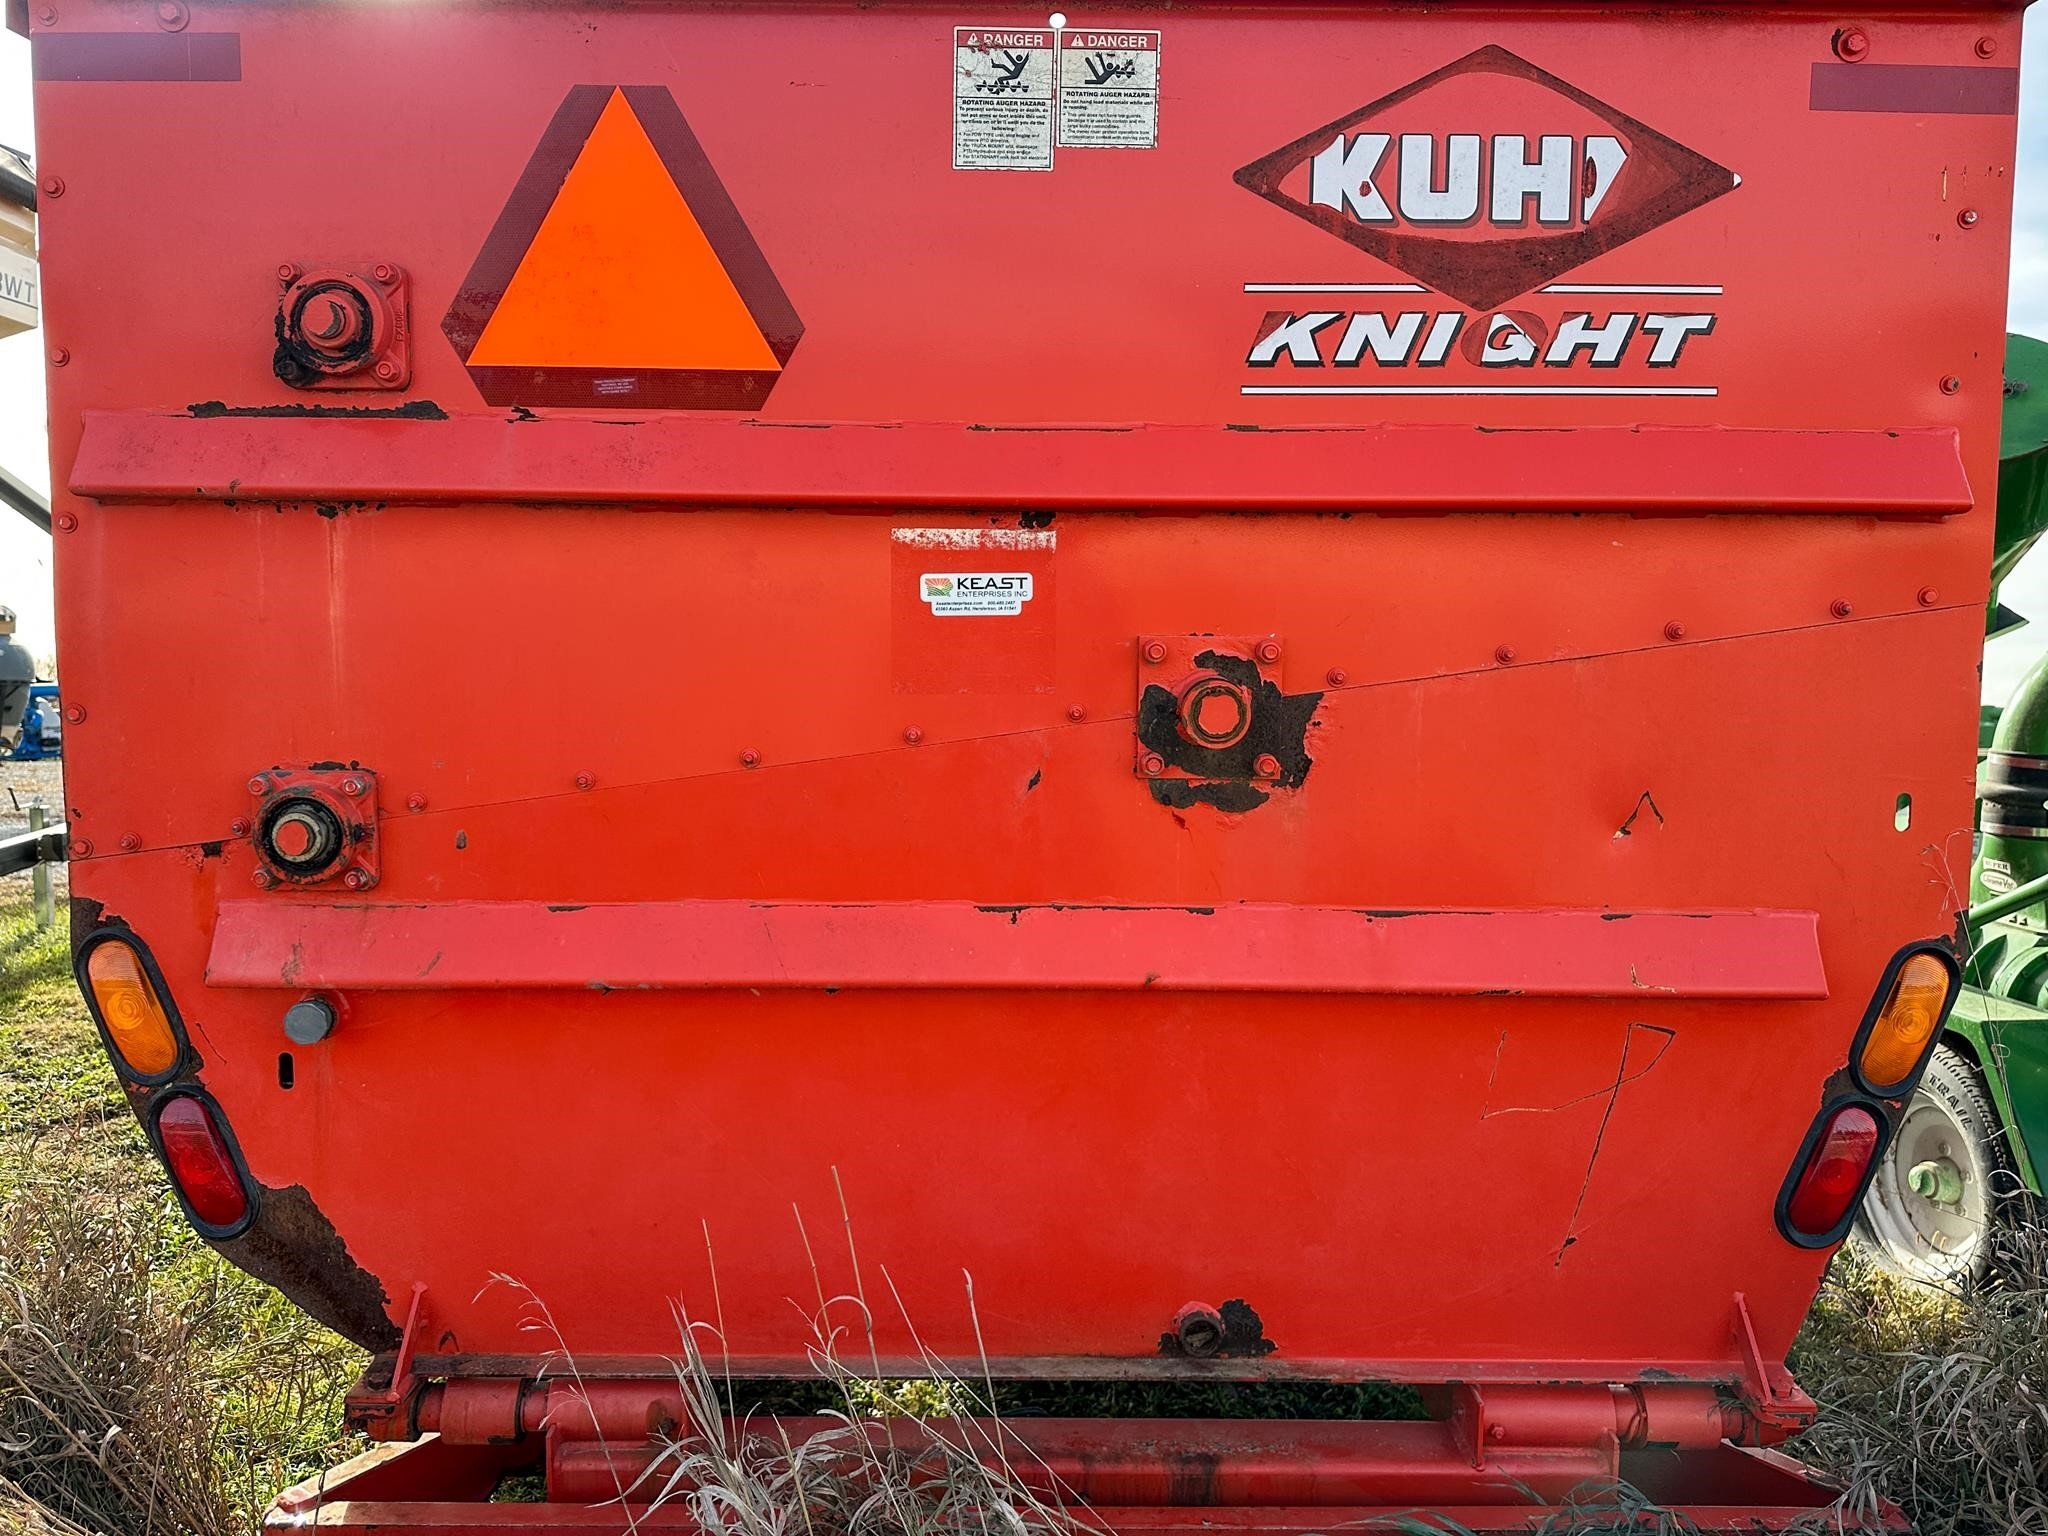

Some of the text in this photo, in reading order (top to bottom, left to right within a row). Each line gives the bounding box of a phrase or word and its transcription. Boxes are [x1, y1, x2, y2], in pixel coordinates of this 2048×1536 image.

[984, 34, 1043, 46] DANGER
[1088, 36, 1147, 48] DANGER
[1246, 311, 1719, 368] KNIGHT
[957, 578, 1028, 589] KEAST
[1928, 1072, 1973, 1131] TRAIL
